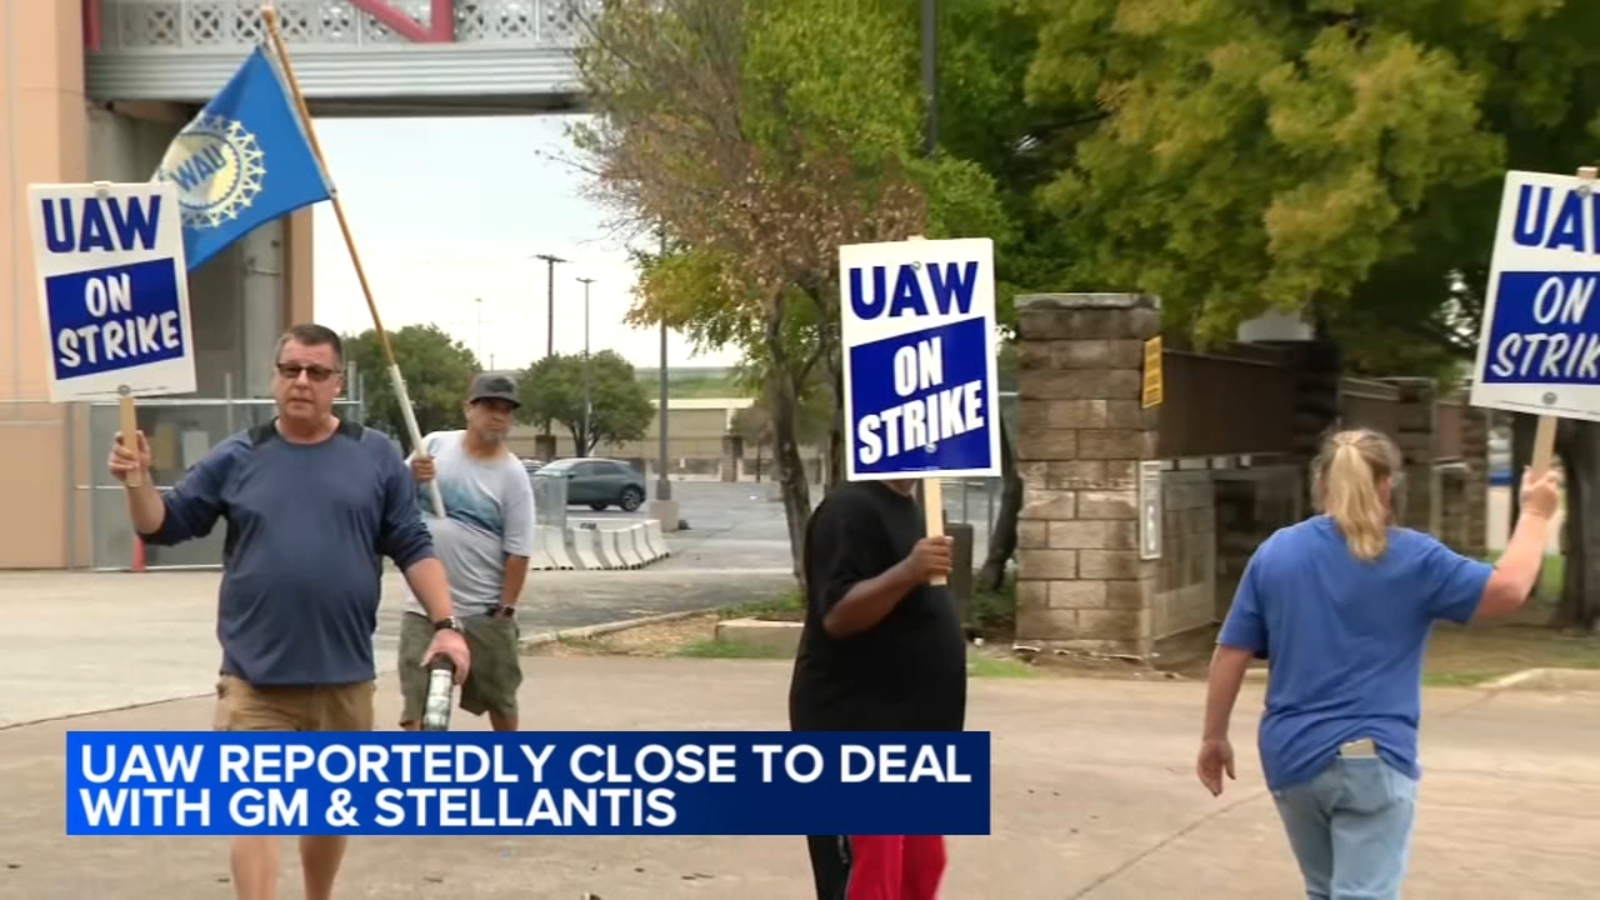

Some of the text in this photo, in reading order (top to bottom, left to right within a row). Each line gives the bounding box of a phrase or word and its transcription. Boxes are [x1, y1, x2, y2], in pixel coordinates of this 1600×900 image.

[41, 194, 162, 254] UAW
[1512, 184, 1600, 254] UA
[84, 272, 133, 318] ON
[849, 261, 979, 321] UAW
[1533, 276, 1597, 325] ON
[57, 311, 181, 369] STRIKE
[893, 336, 944, 397] ON
[1491, 332, 1600, 378] STRIK
[857, 380, 985, 465] STRIKE
